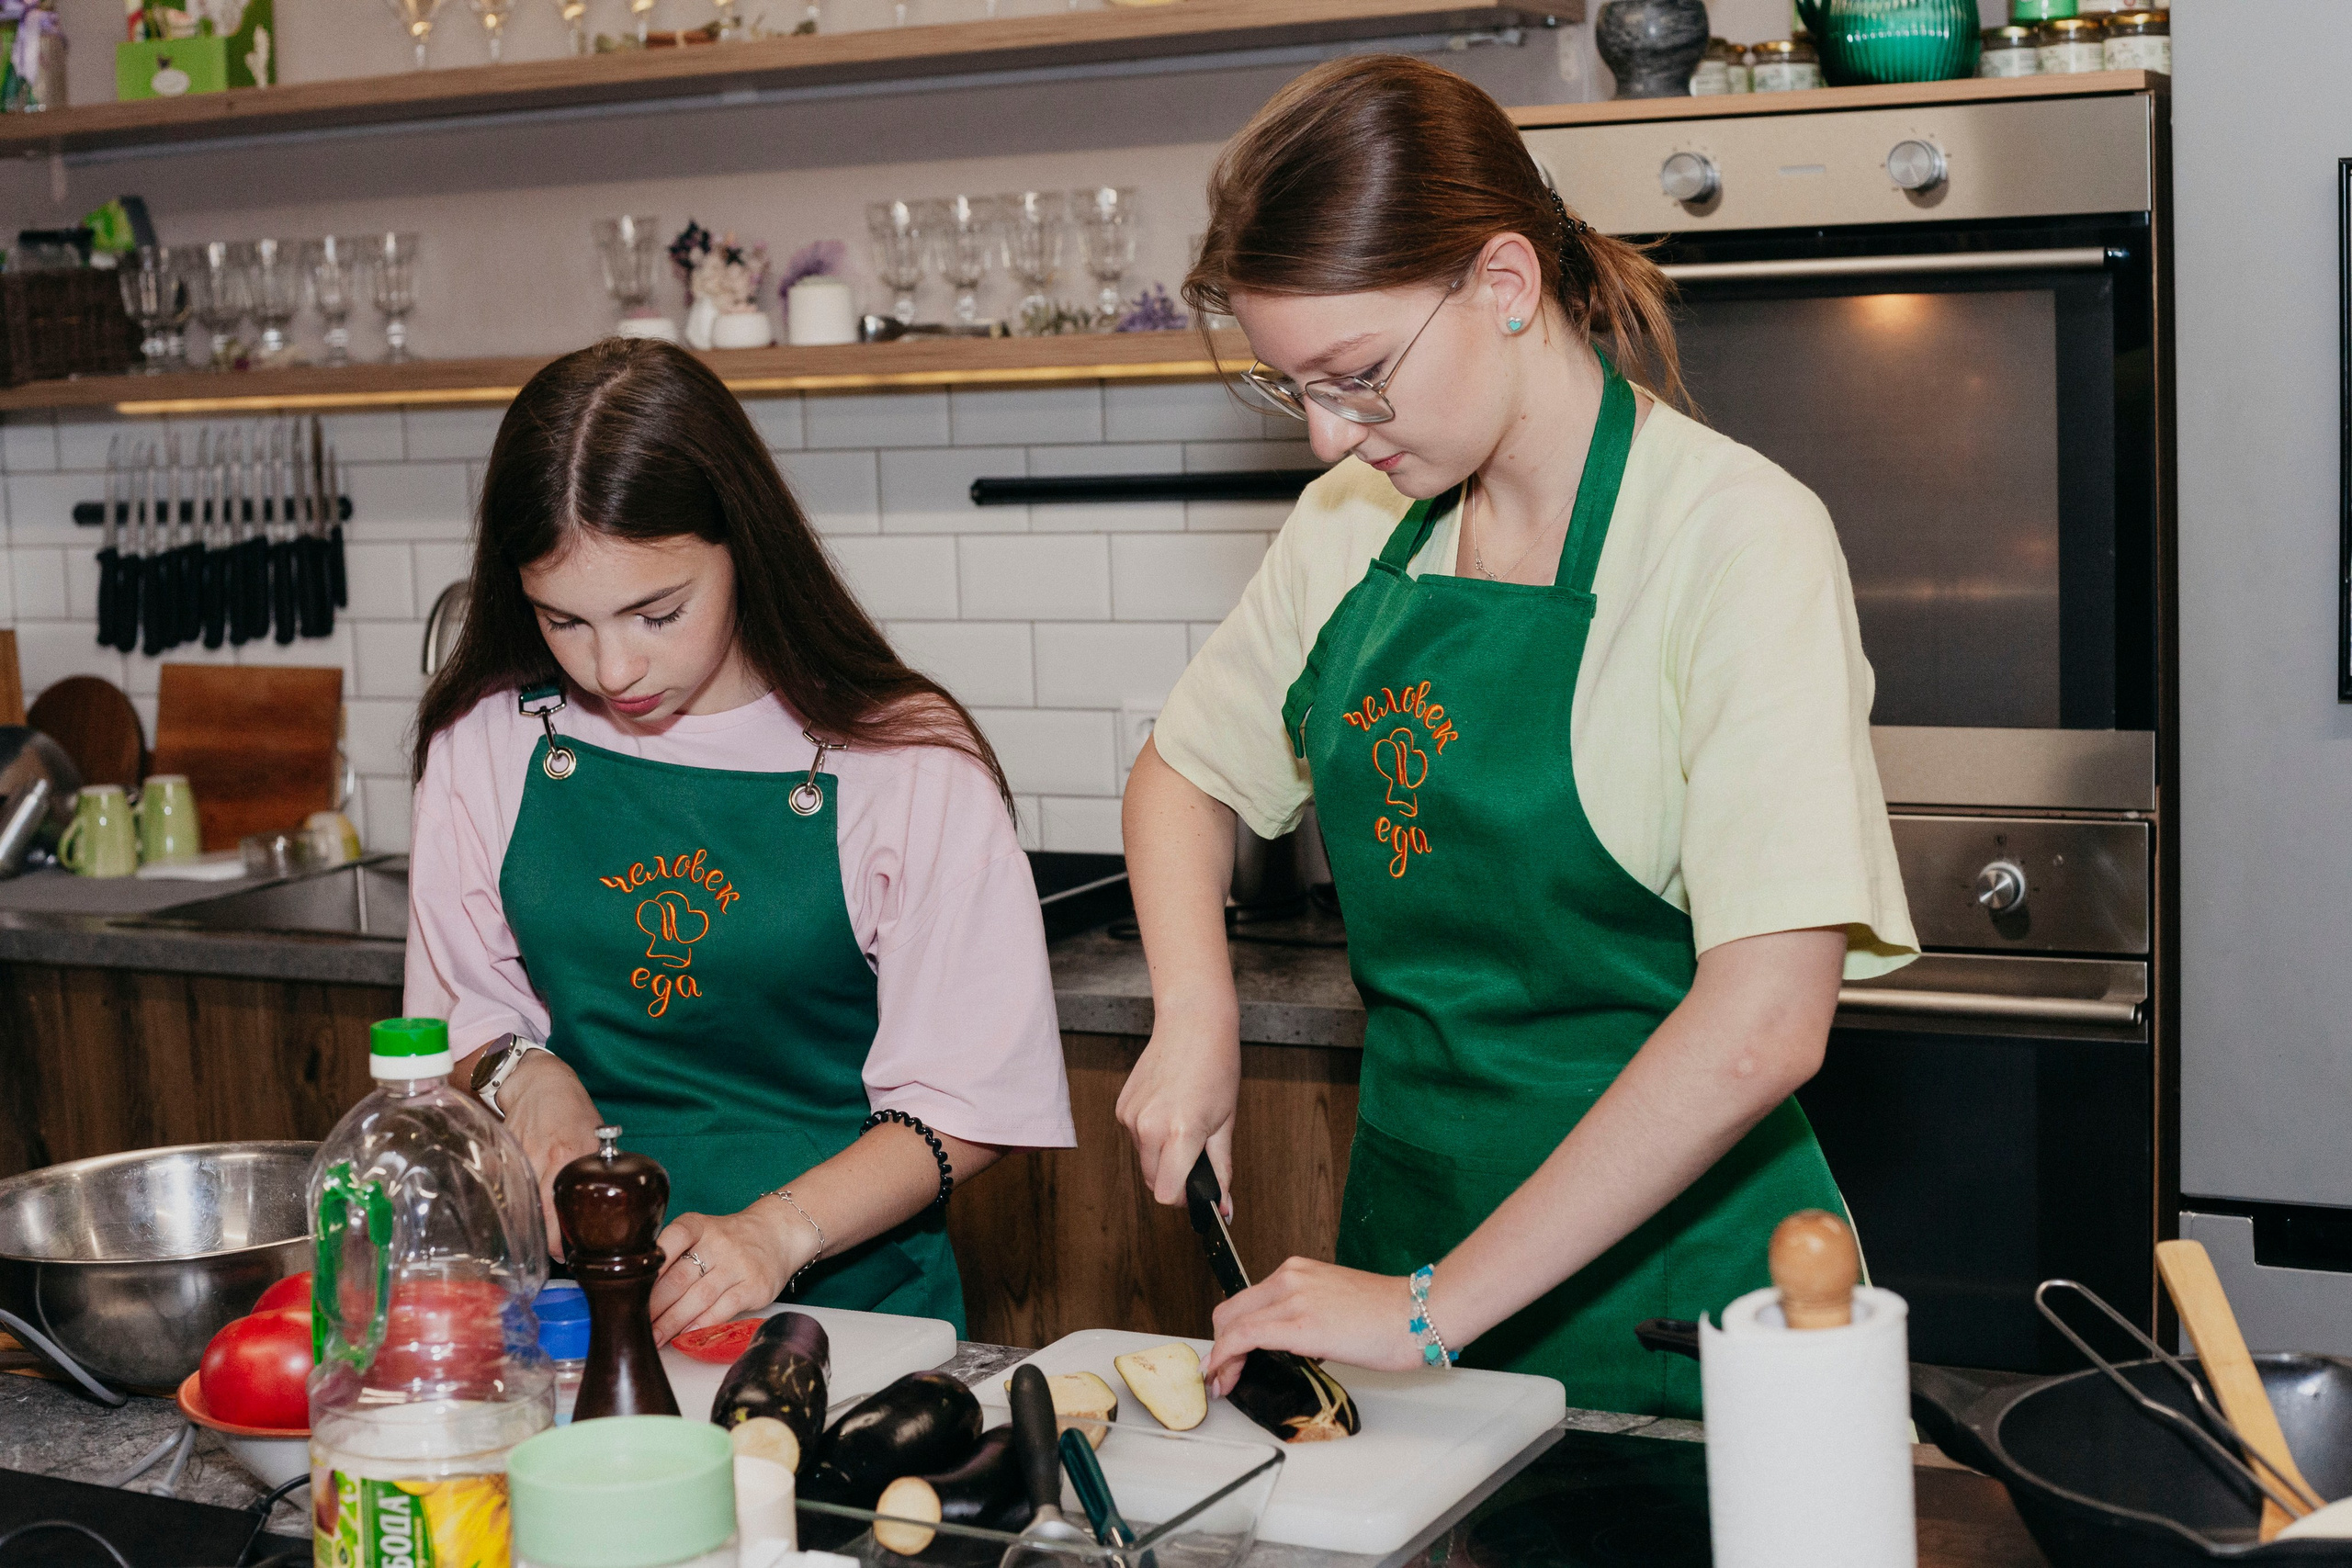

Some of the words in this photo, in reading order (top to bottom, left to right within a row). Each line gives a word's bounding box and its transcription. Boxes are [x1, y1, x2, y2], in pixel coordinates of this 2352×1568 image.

[1342, 680, 1459, 755] человек
[1374, 816, 1432, 879] еда
[599, 849, 741, 915] человек
[629, 967, 703, 1018] еда
